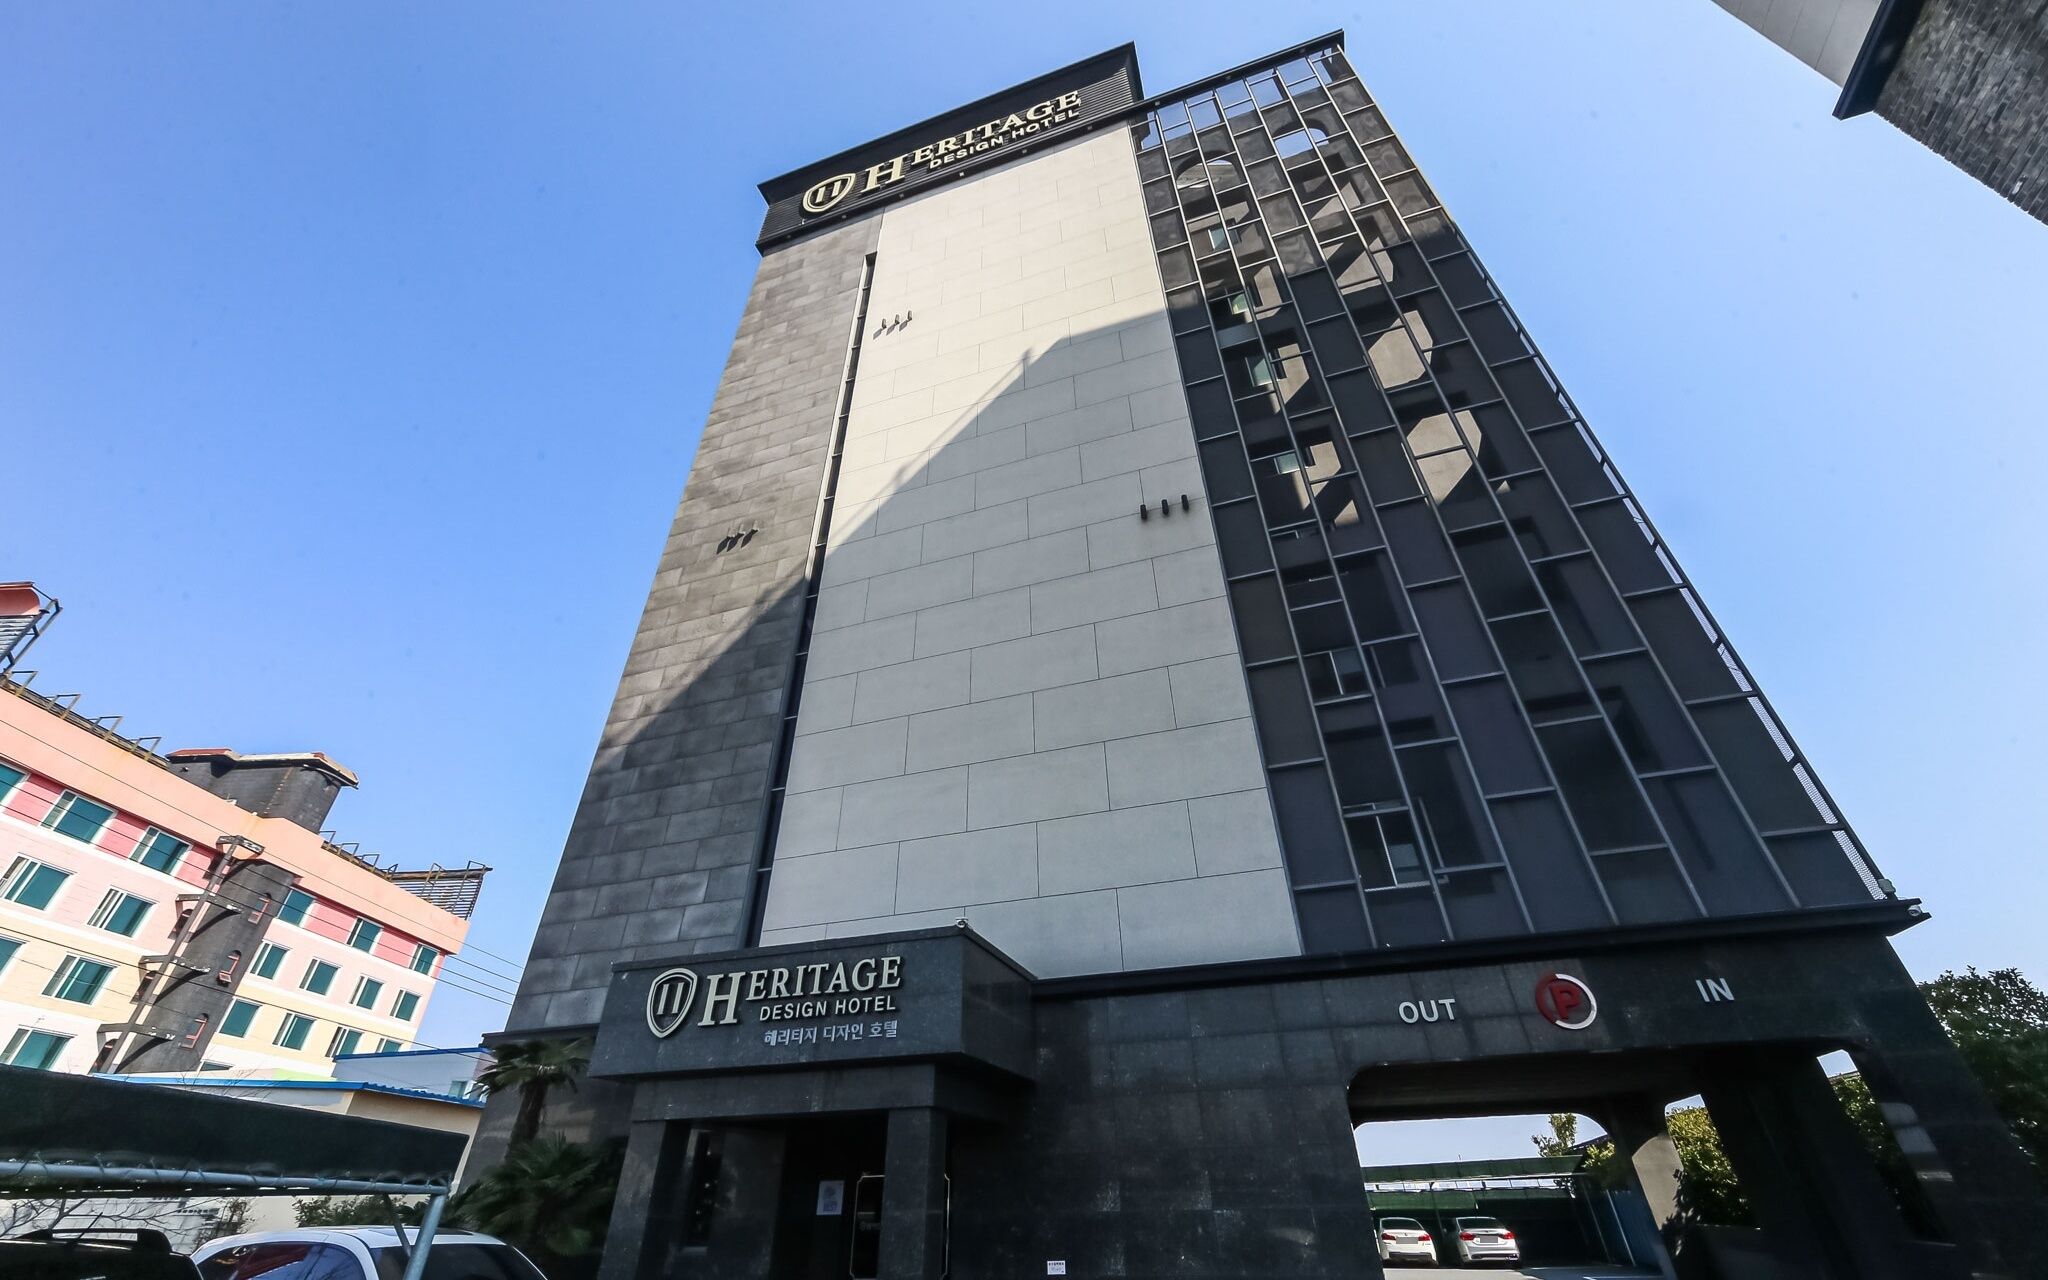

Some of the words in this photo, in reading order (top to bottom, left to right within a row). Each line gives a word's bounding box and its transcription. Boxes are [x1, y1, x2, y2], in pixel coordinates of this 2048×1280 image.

[861, 91, 1082, 193] HERITAGE
[929, 136, 1004, 169] DESIGN
[1012, 109, 1080, 139] HOTEL
[698, 956, 901, 1026] HERITAGE
[1695, 977, 1735, 1002] IN
[759, 1000, 827, 1022] DESIGN
[835, 994, 896, 1016] HOTEL
[1398, 998, 1456, 1024] OUT
[823, 1024, 864, 1042] 디자인
[869, 1020, 898, 1038] 호텔
